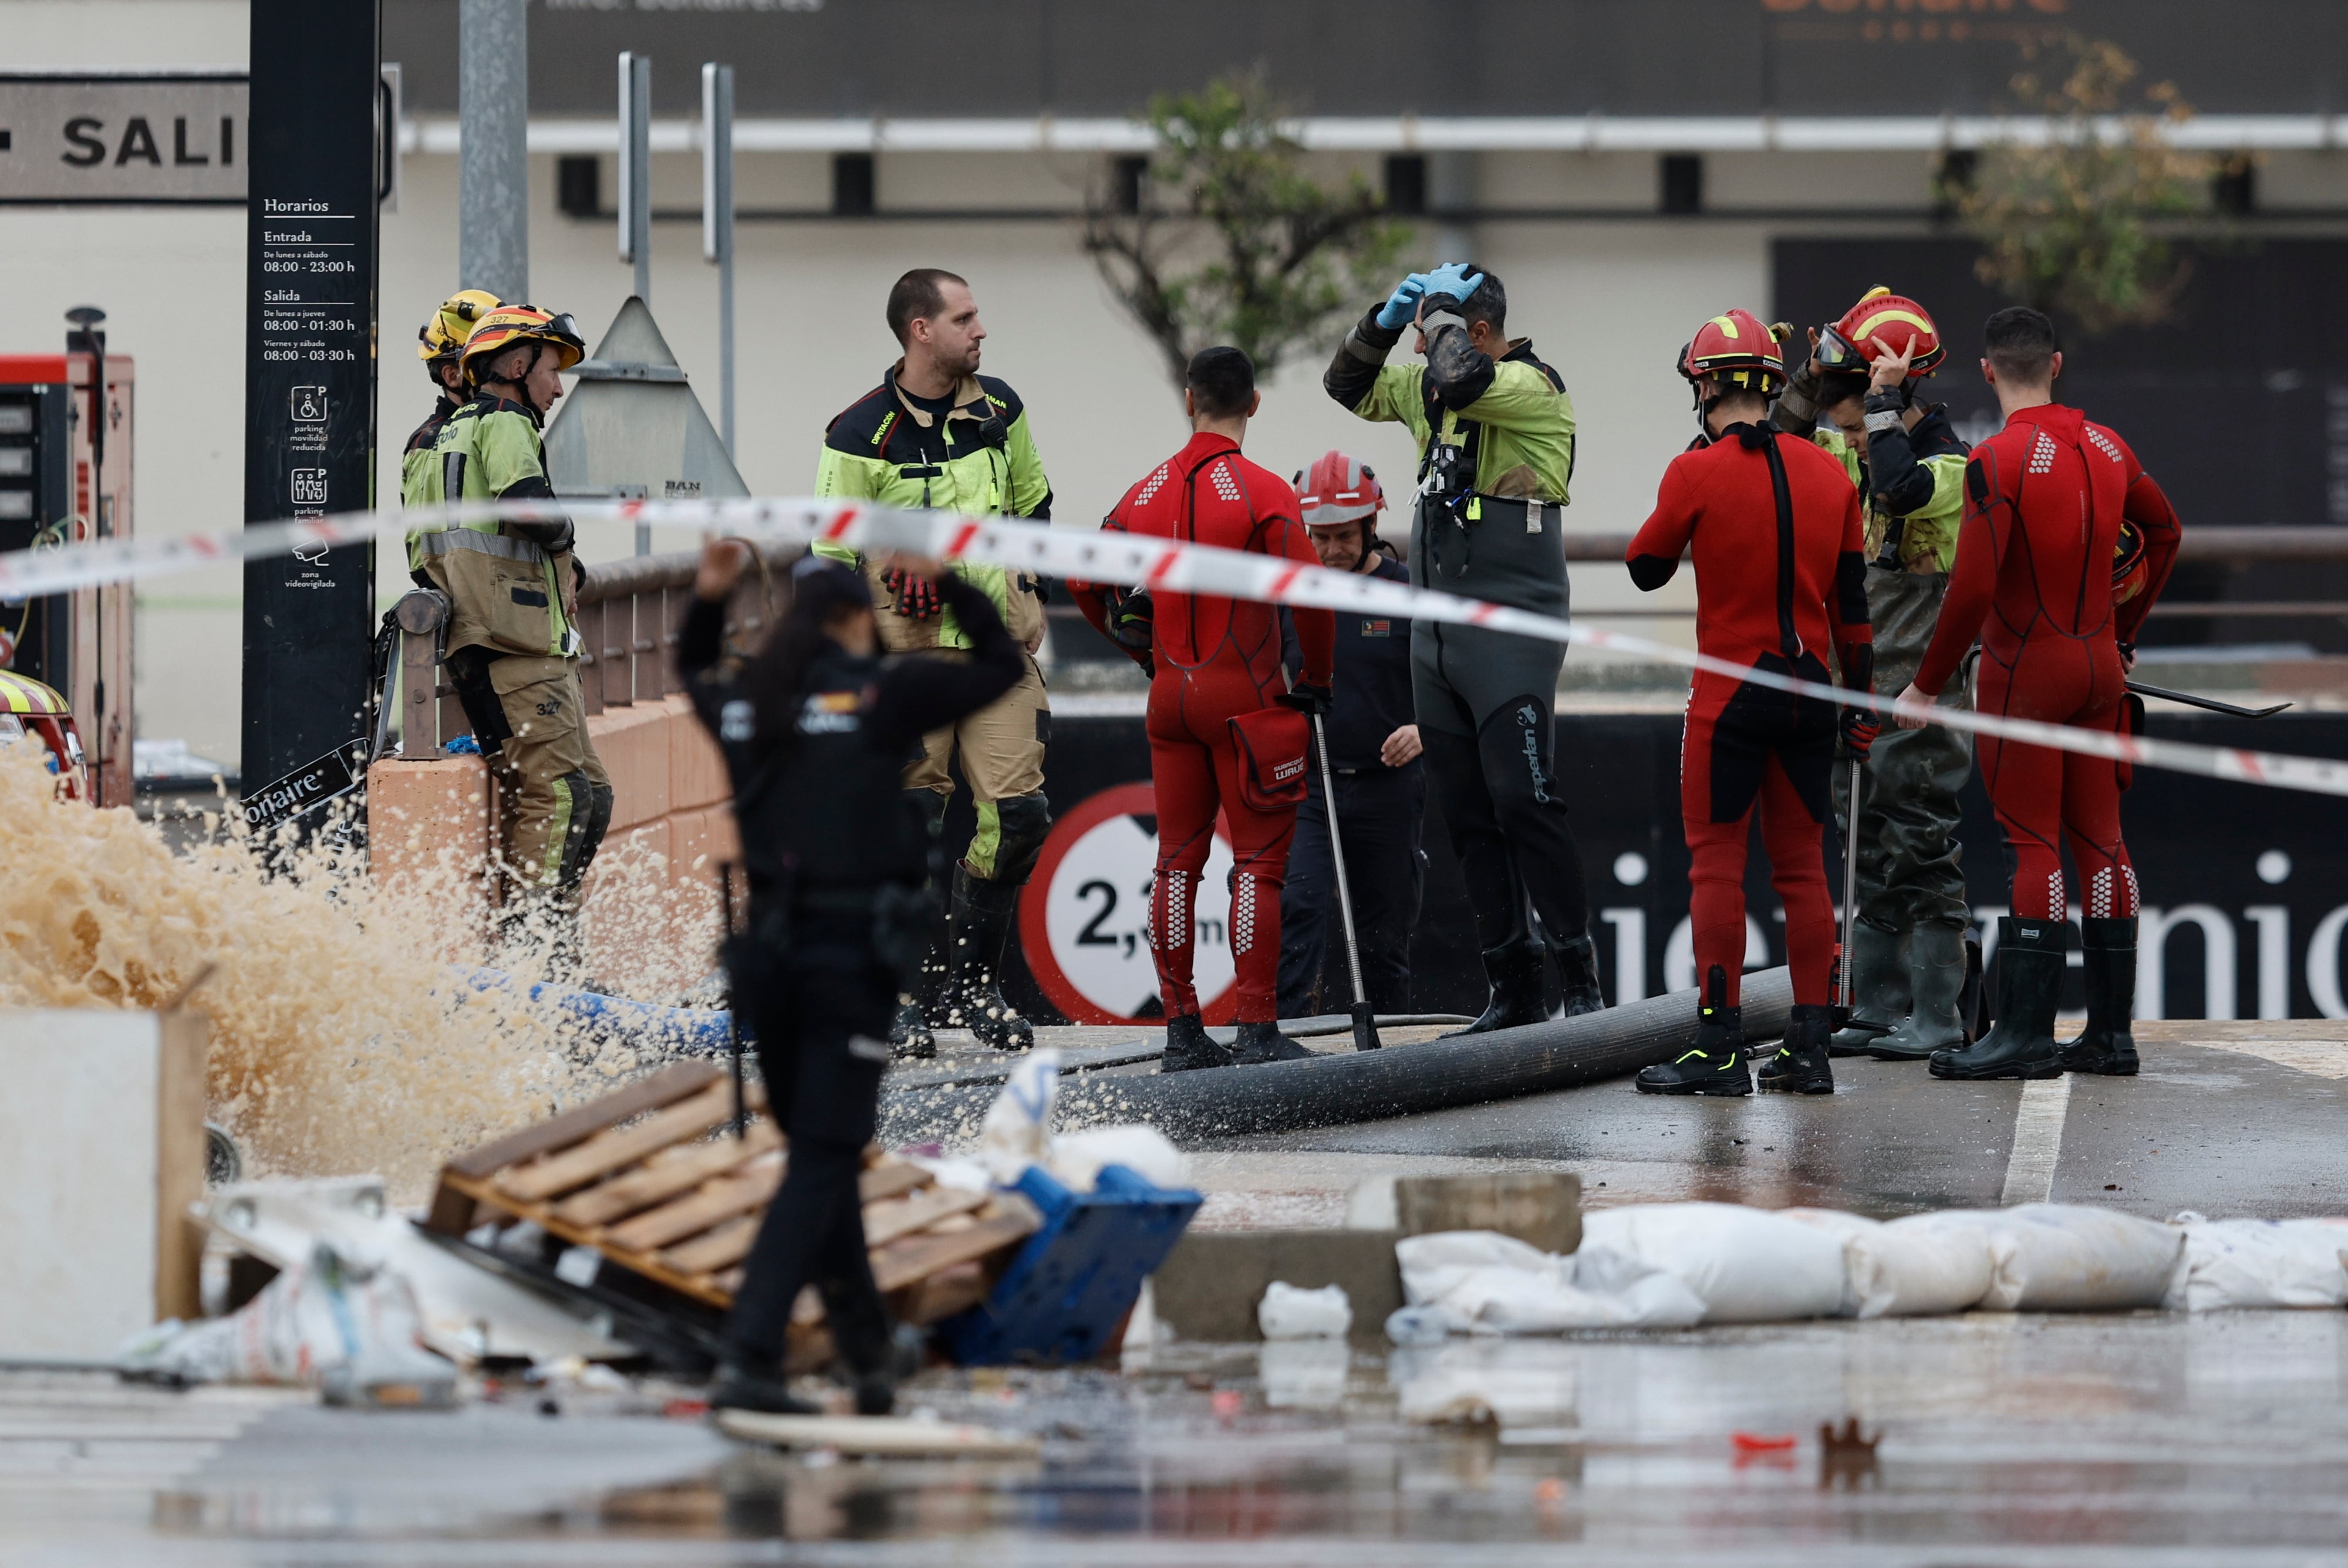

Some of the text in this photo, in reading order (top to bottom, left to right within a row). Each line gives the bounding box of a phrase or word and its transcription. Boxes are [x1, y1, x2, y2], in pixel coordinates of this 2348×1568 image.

[60, 116, 233, 168] SALI
[264, 198, 329, 212] Horarios
[264, 231, 312, 242] Entrada
[264, 262, 298, 272] 08:00
[310, 262, 344, 272] 23:00
[347, 261, 355, 272] h
[264, 289, 301, 301] Salida
[302, 310, 325, 318] jueves
[264, 320, 298, 330] 08:00
[309, 320, 344, 330] 01:30
[347, 319, 355, 330] h
[264, 350, 298, 361] 08:00
[347, 349, 355, 361] h
[294, 424, 323, 434] parking
[294, 508, 323, 517] parking
[285, 580, 335, 590] videovigilada
[536, 701, 562, 716] 327
[1522, 729, 1550, 804] caperlan
